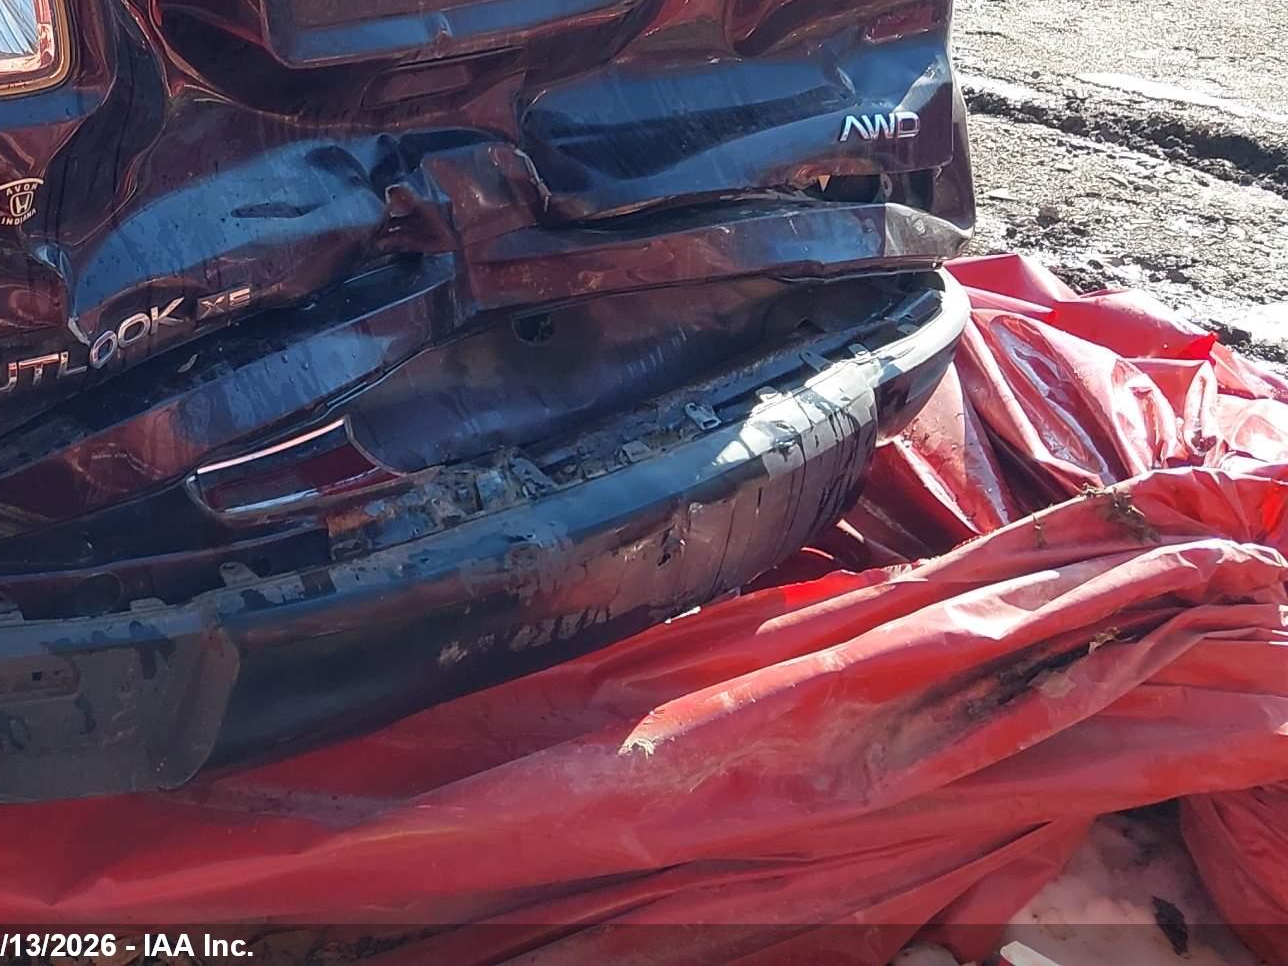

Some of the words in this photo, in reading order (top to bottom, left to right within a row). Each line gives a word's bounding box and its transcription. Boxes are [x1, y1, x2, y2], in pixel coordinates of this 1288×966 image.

[839, 110, 921, 142] AWD
[5, 183, 38, 197] AVON
[0, 207, 37, 226] INDIANA
[199, 286, 251, 320] XE
